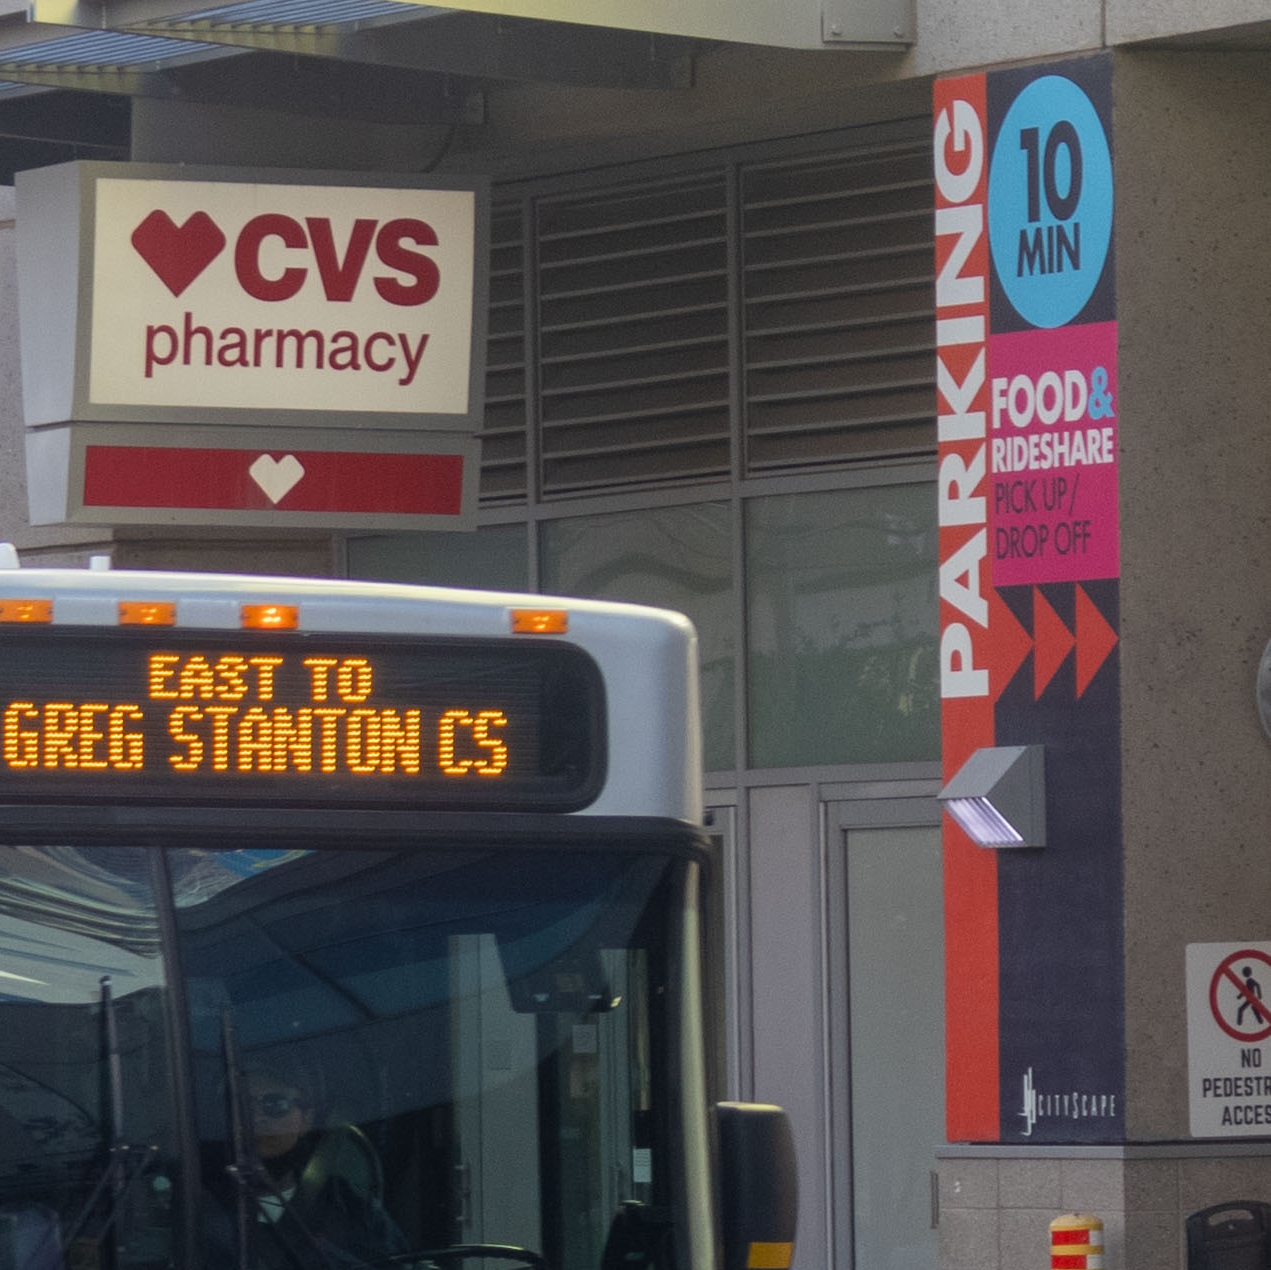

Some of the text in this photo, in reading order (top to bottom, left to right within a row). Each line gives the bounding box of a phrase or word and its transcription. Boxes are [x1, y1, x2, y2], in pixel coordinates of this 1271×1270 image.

[1020, 120, 1083, 223] 10
[235, 213, 440, 306] CVS
[1017, 222, 1080, 277] MIN
[144, 311, 430, 386] pharmacy
[934, 100, 989, 698] PARKING
[992, 427, 1114, 473] RIDESHARE
[995, 480, 1037, 514] PICK
[996, 520, 1091, 560] DROP OFF
[149, 655, 372, 702] EAST TO
[2, 702, 508, 774] GREG STANTON CS
[1240, 1048, 1262, 1068] NO
